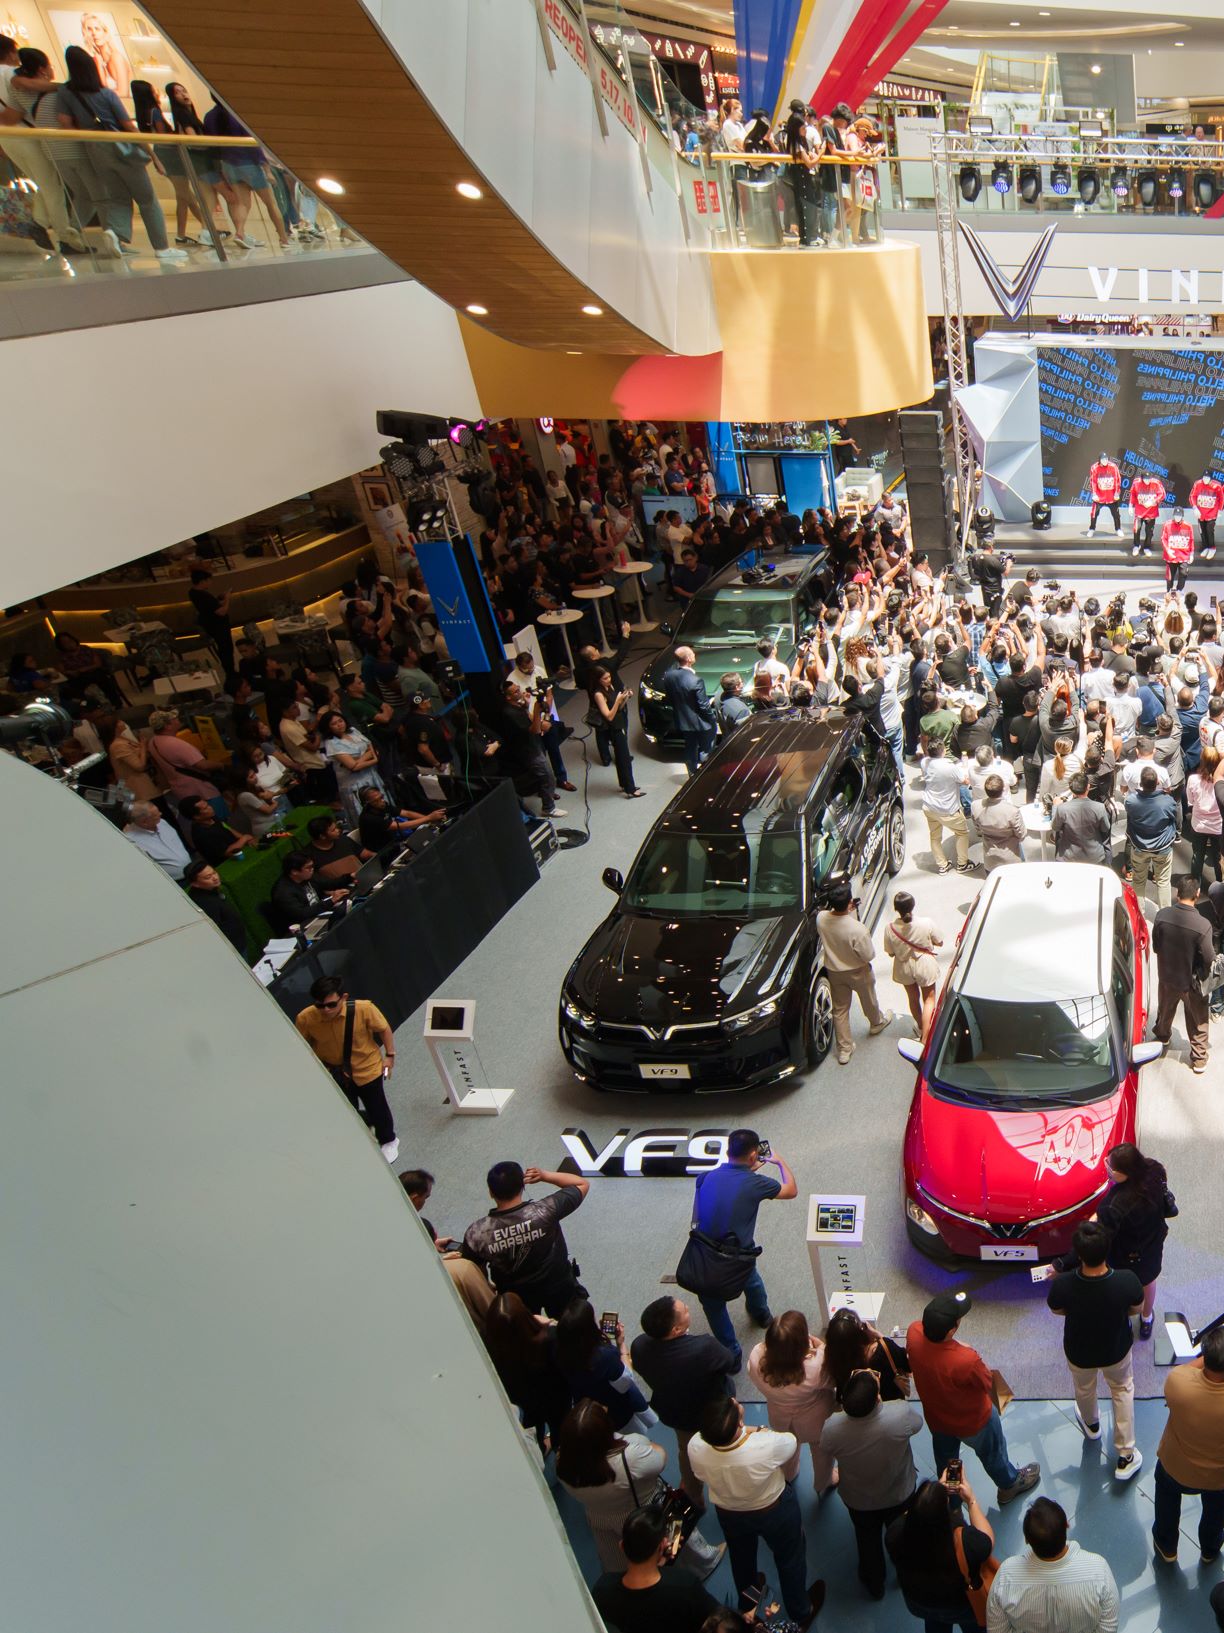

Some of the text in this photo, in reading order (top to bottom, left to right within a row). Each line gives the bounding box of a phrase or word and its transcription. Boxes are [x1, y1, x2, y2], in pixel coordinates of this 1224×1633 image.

[453, 1050, 476, 1095] VINFAST
[651, 1068, 678, 1076] VF9
[560, 1133, 729, 1174] VF9
[488, 1229, 546, 1254] MARSHAL
[493, 1220, 532, 1242] EVENT
[837, 1256, 855, 1304] VINFAST
